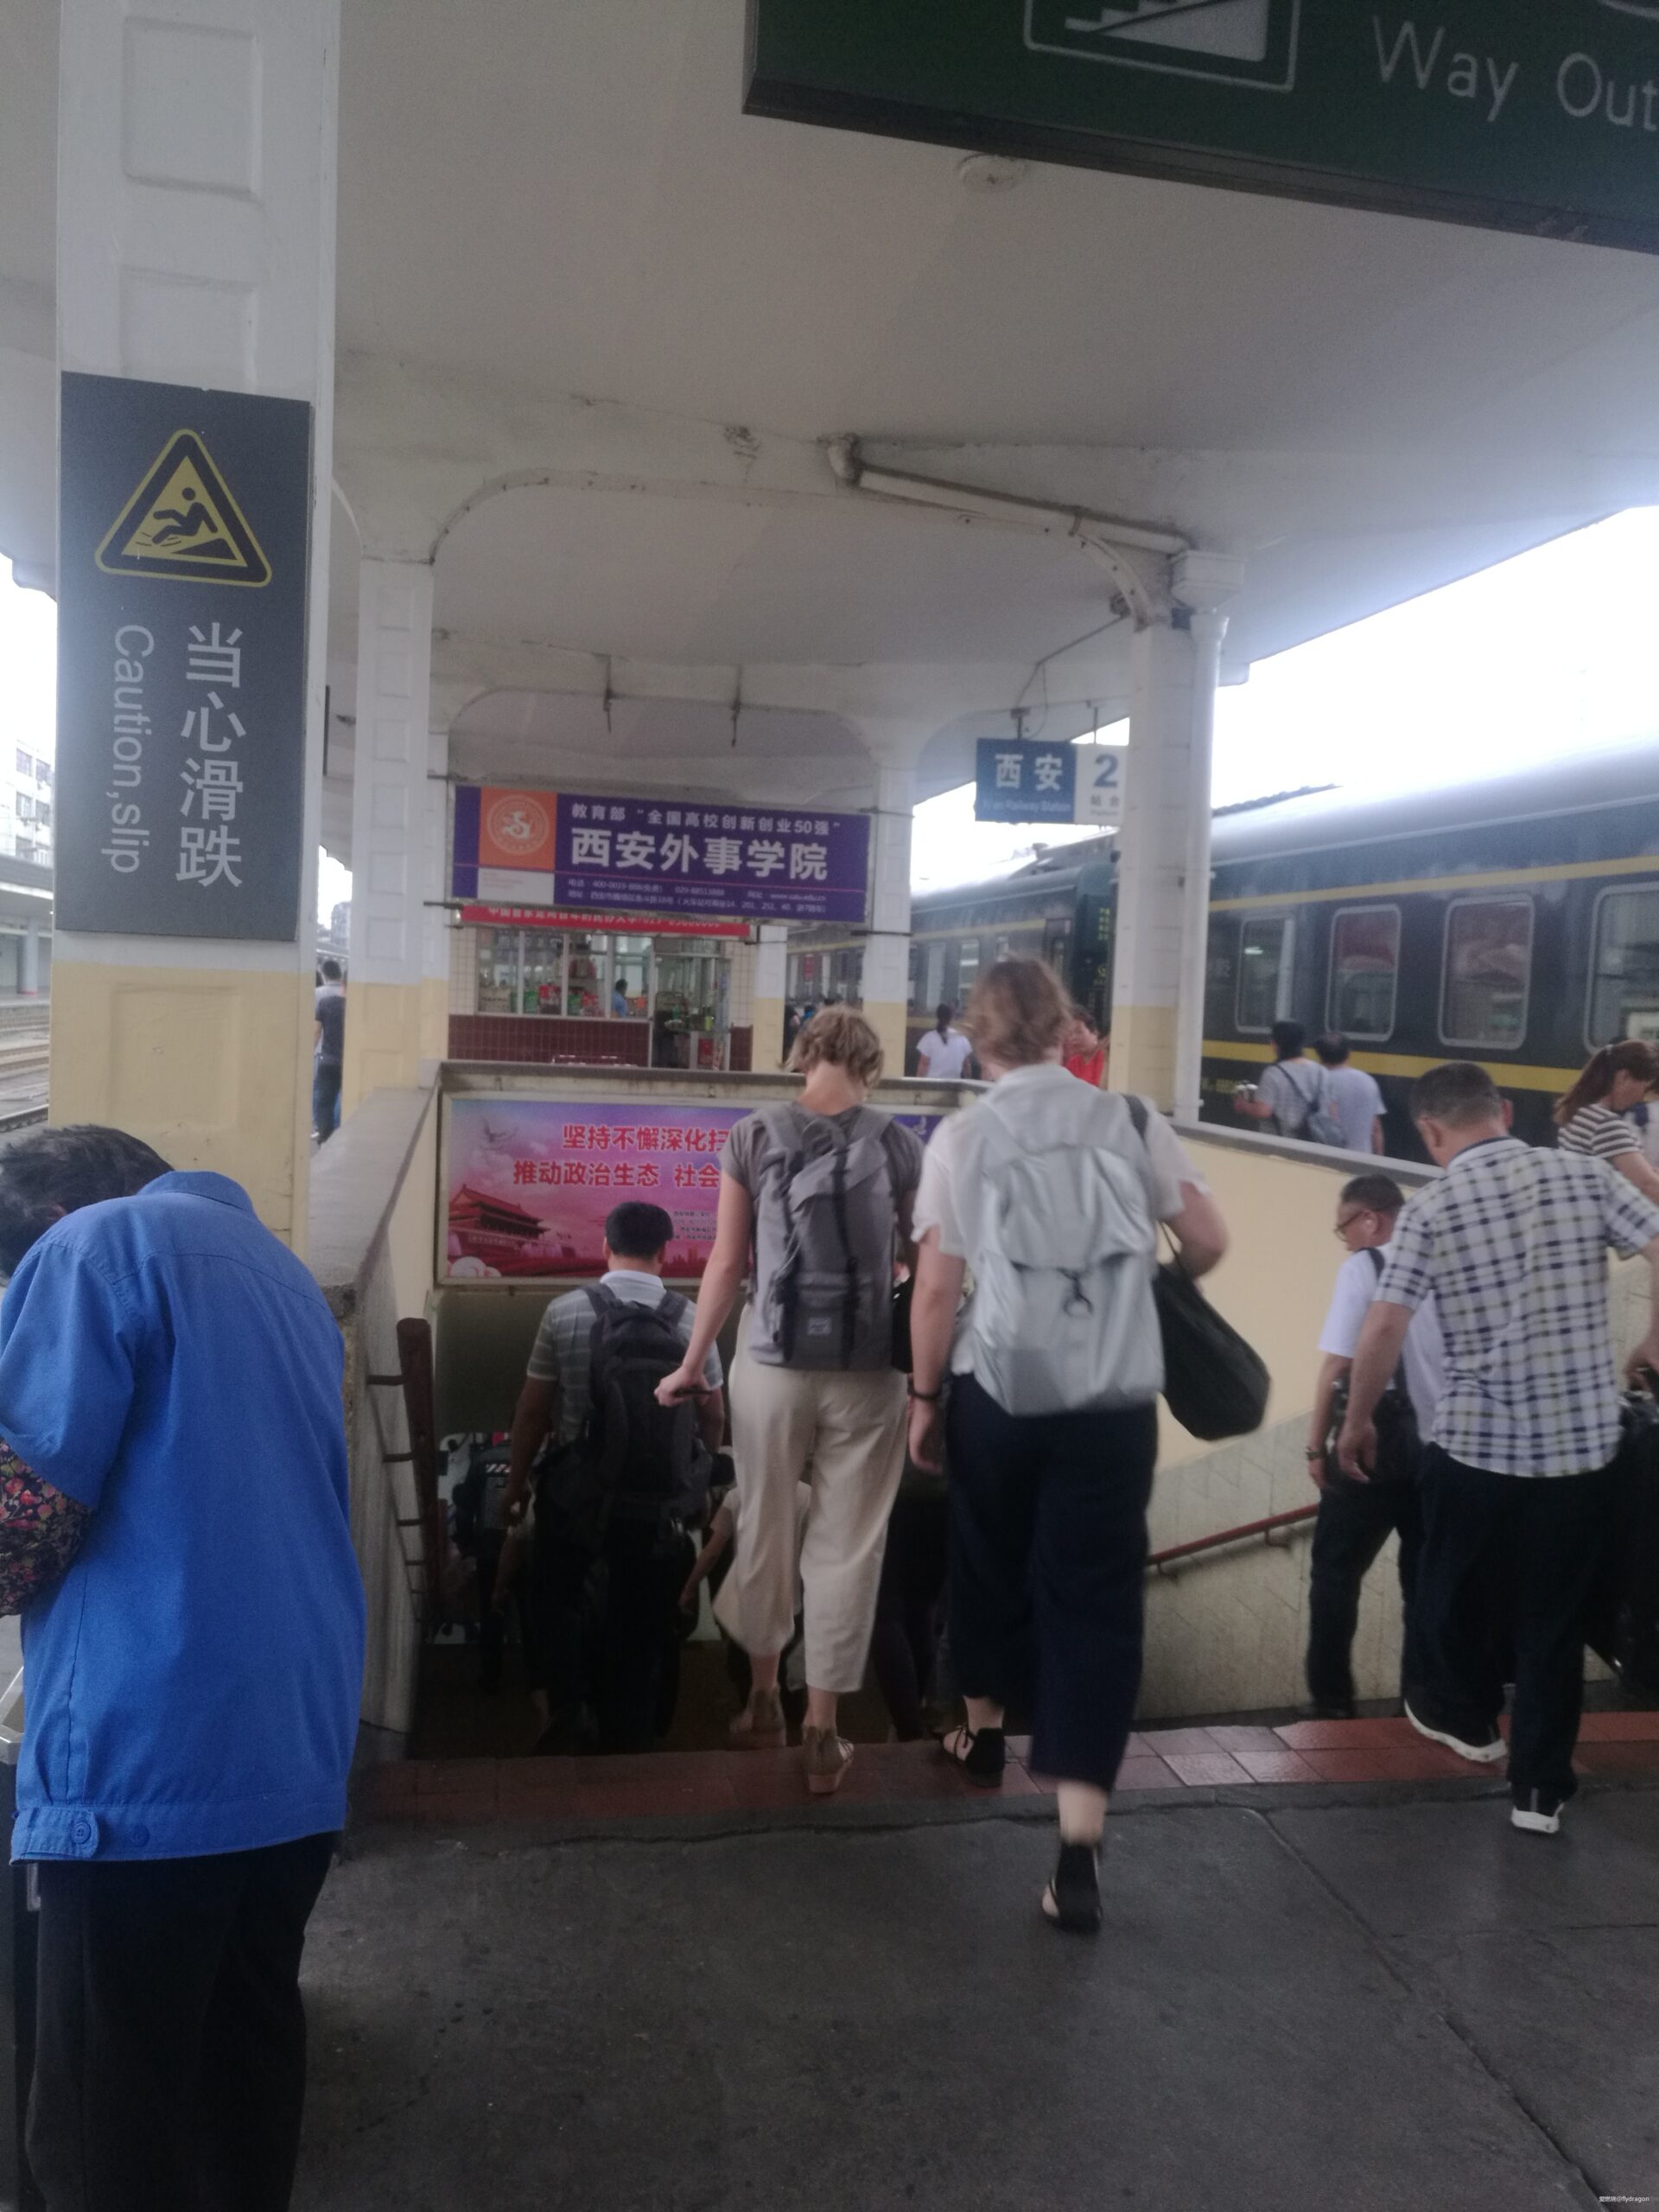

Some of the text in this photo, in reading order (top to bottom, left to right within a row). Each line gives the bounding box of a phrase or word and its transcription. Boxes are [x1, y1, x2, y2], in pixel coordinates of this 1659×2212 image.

[1374, 16, 1659, 130] Way Out
[102, 624, 155, 874] Caution,slip
[175, 622, 246, 888] 当心滑跌
[995, 753, 1063, 791] 西安
[1093, 753, 1118, 788] 2
[571, 802, 626, 822] 教育部
[571, 827, 828, 881] 西安外事学院
[513, 1160, 720, 1187] 推动政治生态 社会
